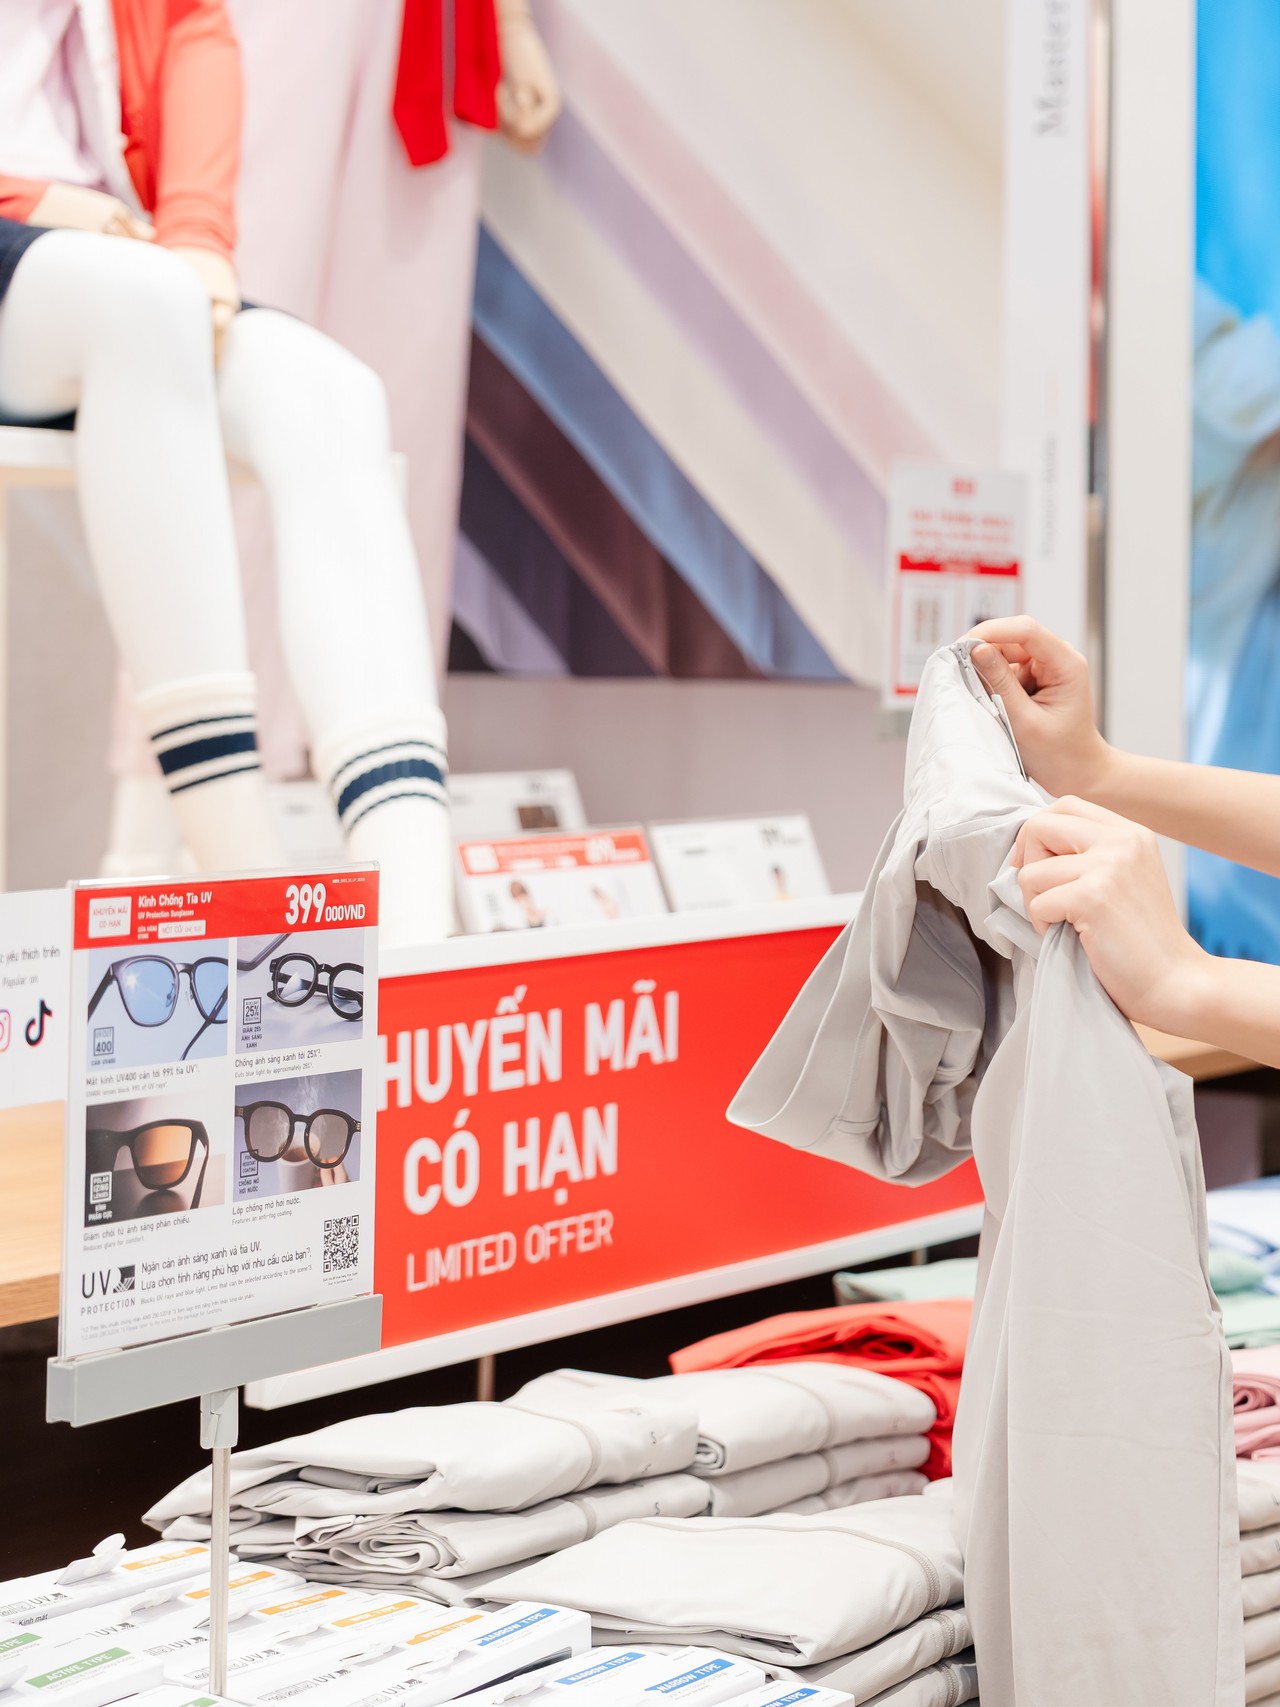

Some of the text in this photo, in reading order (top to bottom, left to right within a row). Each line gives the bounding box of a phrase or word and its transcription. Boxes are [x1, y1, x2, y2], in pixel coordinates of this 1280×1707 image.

[186, 892, 198, 904] Tia
[201, 891, 212, 903] UV
[285, 882, 365, 925] 399 000VND
[246, 1005, 259, 1017] 25%
[96, 1040, 112, 1053] 400
[378, 978, 679, 1112] HUYẾN MÃI
[116, 1071, 137, 1082] UV400
[403, 1102, 618, 1216] CÓ HẠN
[211, 1247, 228, 1260] xanh
[253, 1258, 265, 1270] nhu
[406, 1209, 614, 1293] LIMITED OFFER
[82, 1269, 111, 1299] UV
[80, 1298, 136, 1317] PROTECTION
[483, 1612, 547, 1642] NARROW TYPE
[46, 1664, 83, 1681] ACTIVE
[83, 1653, 112, 1667] TYPE
[569, 1654, 633, 1681] NARROW TYPE
[657, 1663, 721, 1692] NARROW TYPE
[782, 1691, 807, 1704] TYPE
